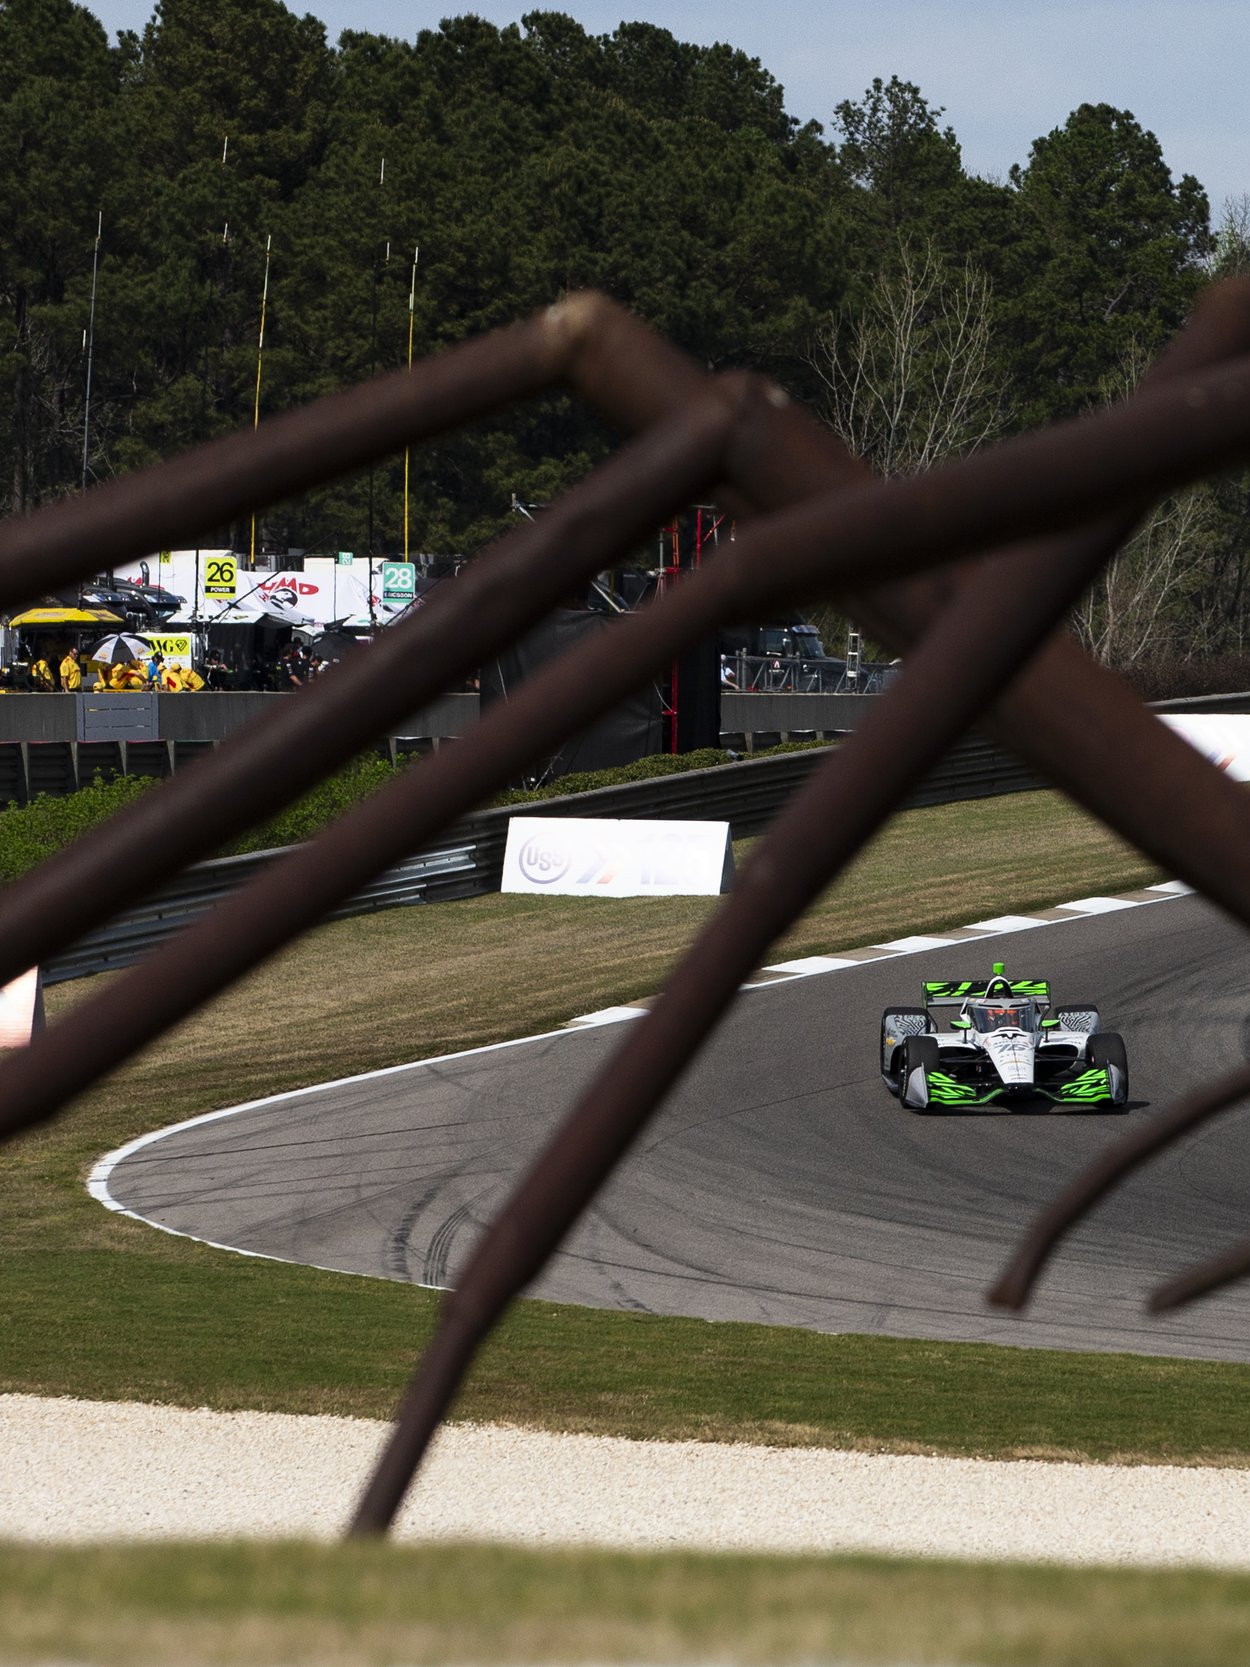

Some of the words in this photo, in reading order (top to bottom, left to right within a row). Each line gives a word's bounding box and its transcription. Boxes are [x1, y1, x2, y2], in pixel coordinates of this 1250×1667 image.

[207, 562, 234, 582] 26
[385, 567, 413, 589] 28
[526, 846, 564, 872] USS
